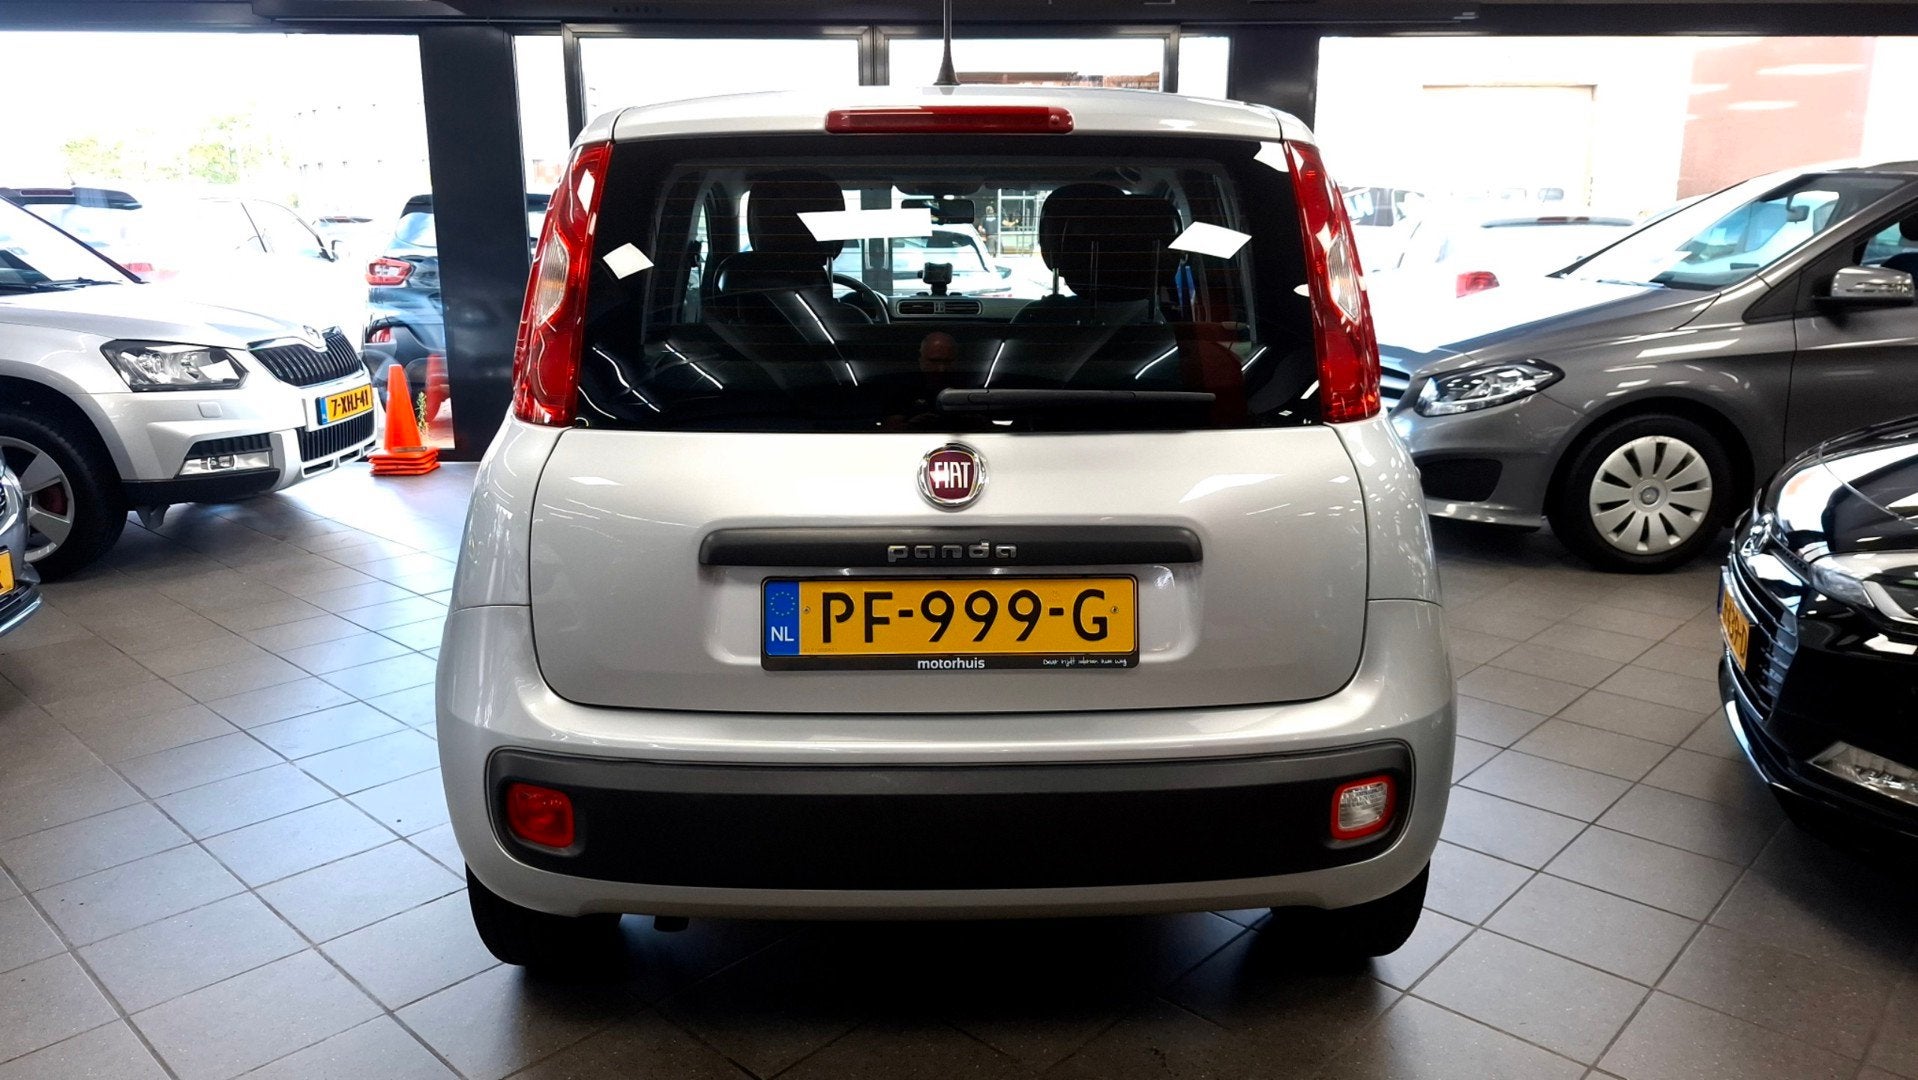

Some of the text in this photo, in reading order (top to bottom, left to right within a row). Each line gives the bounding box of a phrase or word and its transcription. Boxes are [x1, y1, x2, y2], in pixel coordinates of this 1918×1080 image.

[331, 389, 369, 417] 7-XHJ-41
[934, 461, 971, 489] FIAT
[887, 542, 1017, 562] panda
[770, 588, 1108, 643] NL PF-999-G
[917, 657, 985, 669] motorhuis
